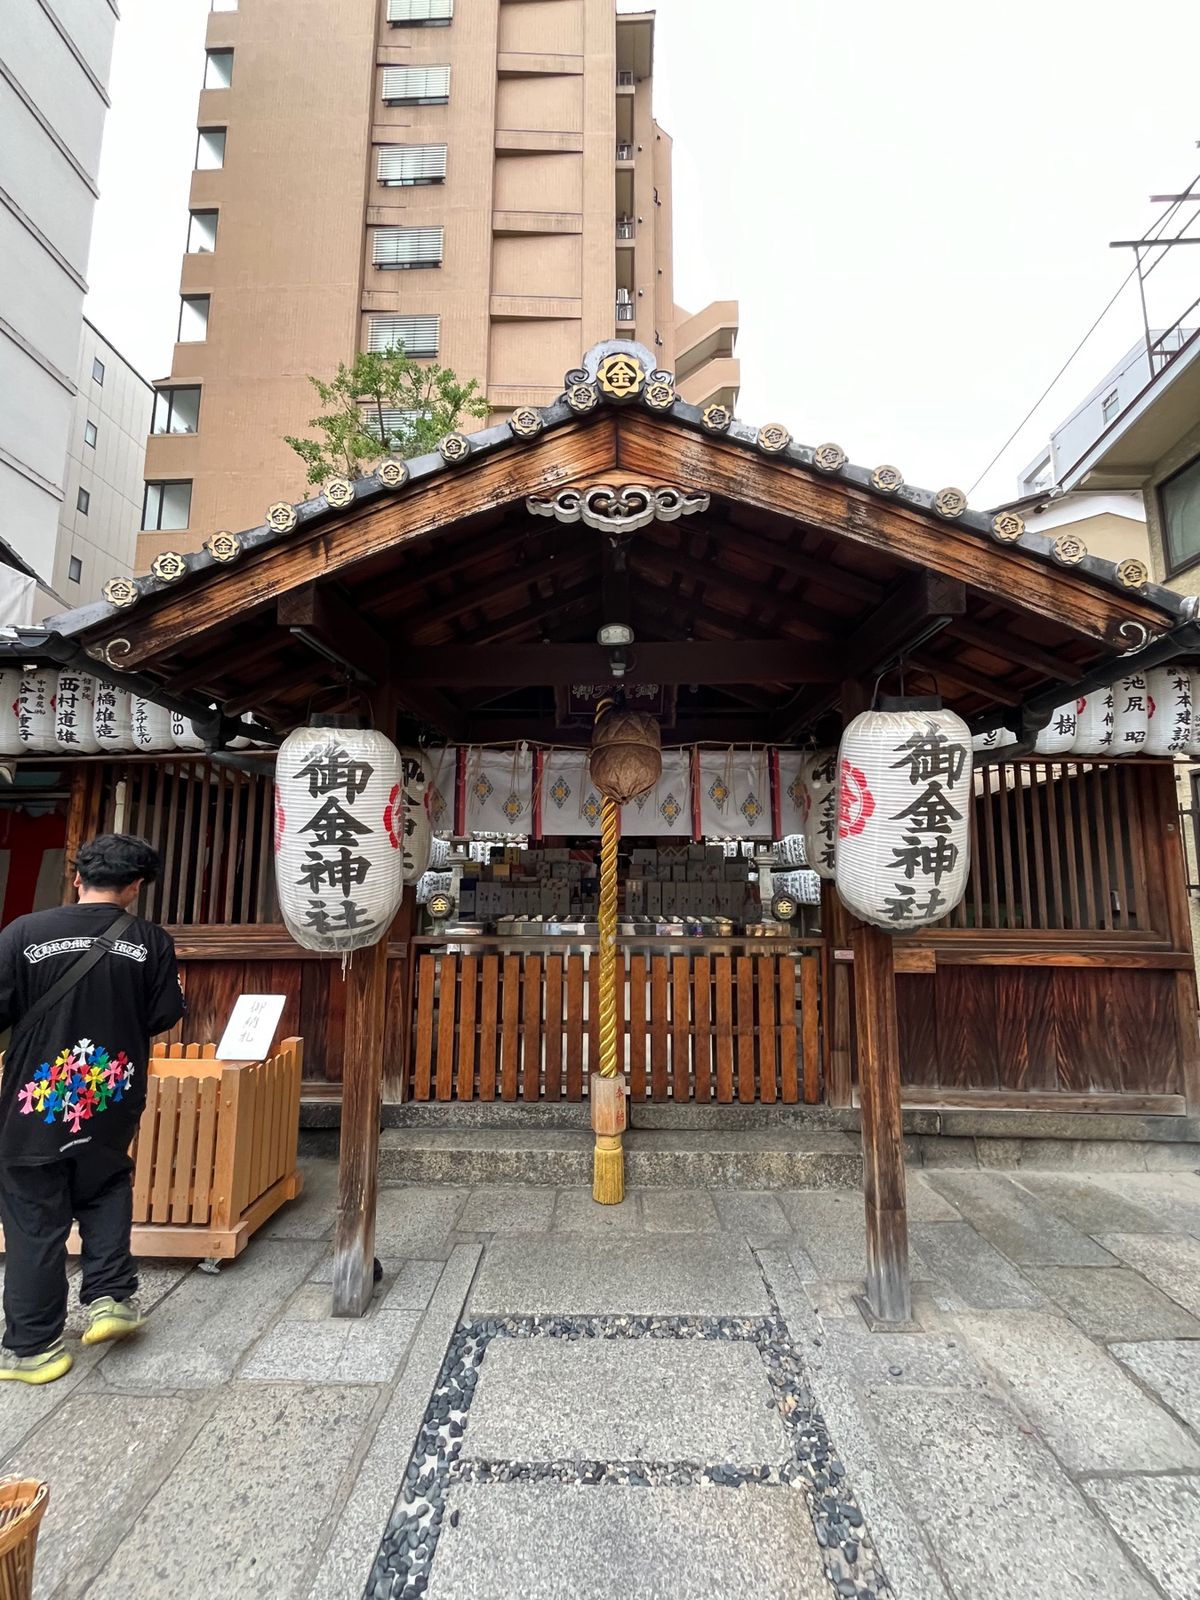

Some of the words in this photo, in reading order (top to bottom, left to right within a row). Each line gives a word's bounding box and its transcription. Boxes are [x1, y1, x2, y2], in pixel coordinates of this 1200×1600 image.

[606, 361, 637, 386] 金
[57, 677, 80, 744] 西村道雄
[292, 738, 376, 936] 御金神社
[875, 720, 968, 922] 御金神社
